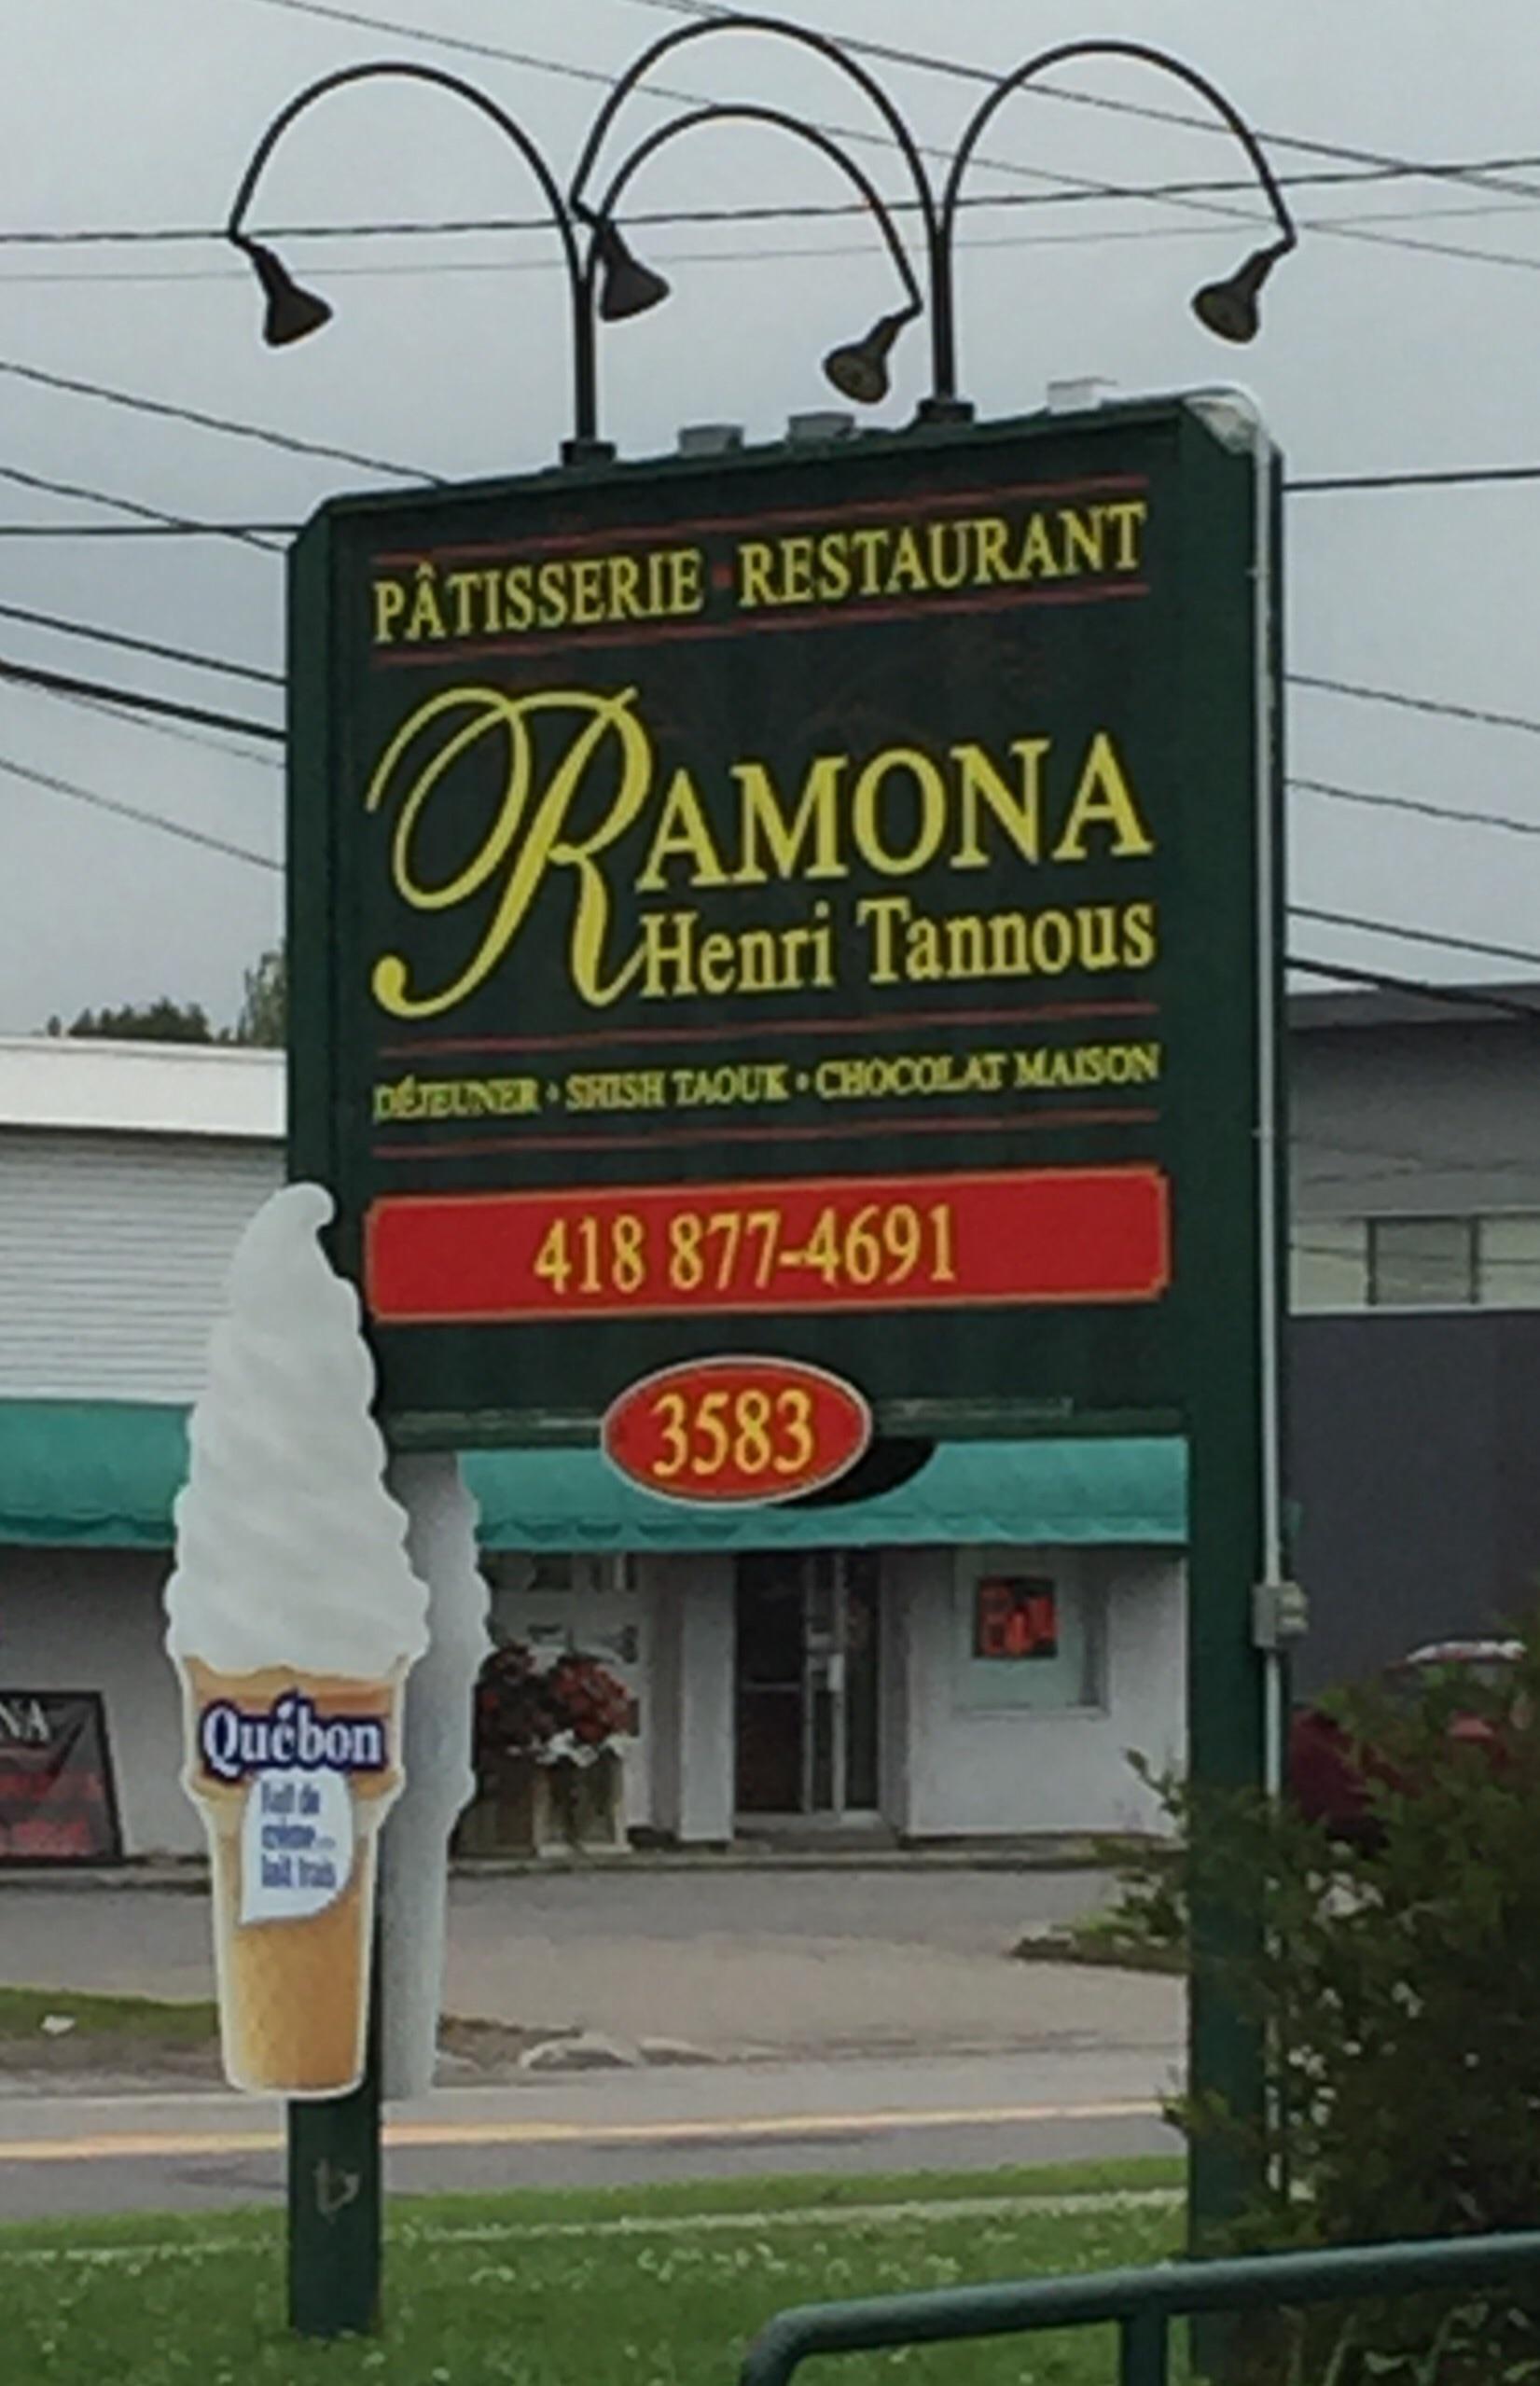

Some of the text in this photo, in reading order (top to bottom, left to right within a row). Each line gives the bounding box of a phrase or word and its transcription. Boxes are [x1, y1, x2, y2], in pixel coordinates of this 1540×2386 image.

[374, 501, 1146, 644] PÂTISSERIE RESTAURANT
[368, 687, 1154, 1017] RAMONA
[638, 895, 1154, 998] Henri Tannous
[374, 1043, 1159, 1121] DÉJEUNER SHISH TAOUK CHOCOLAT MAISON
[534, 1203, 955, 1294] 418 877-4691
[652, 1388, 813, 1477] 3583
[201, 1701, 382, 1777] Québon
